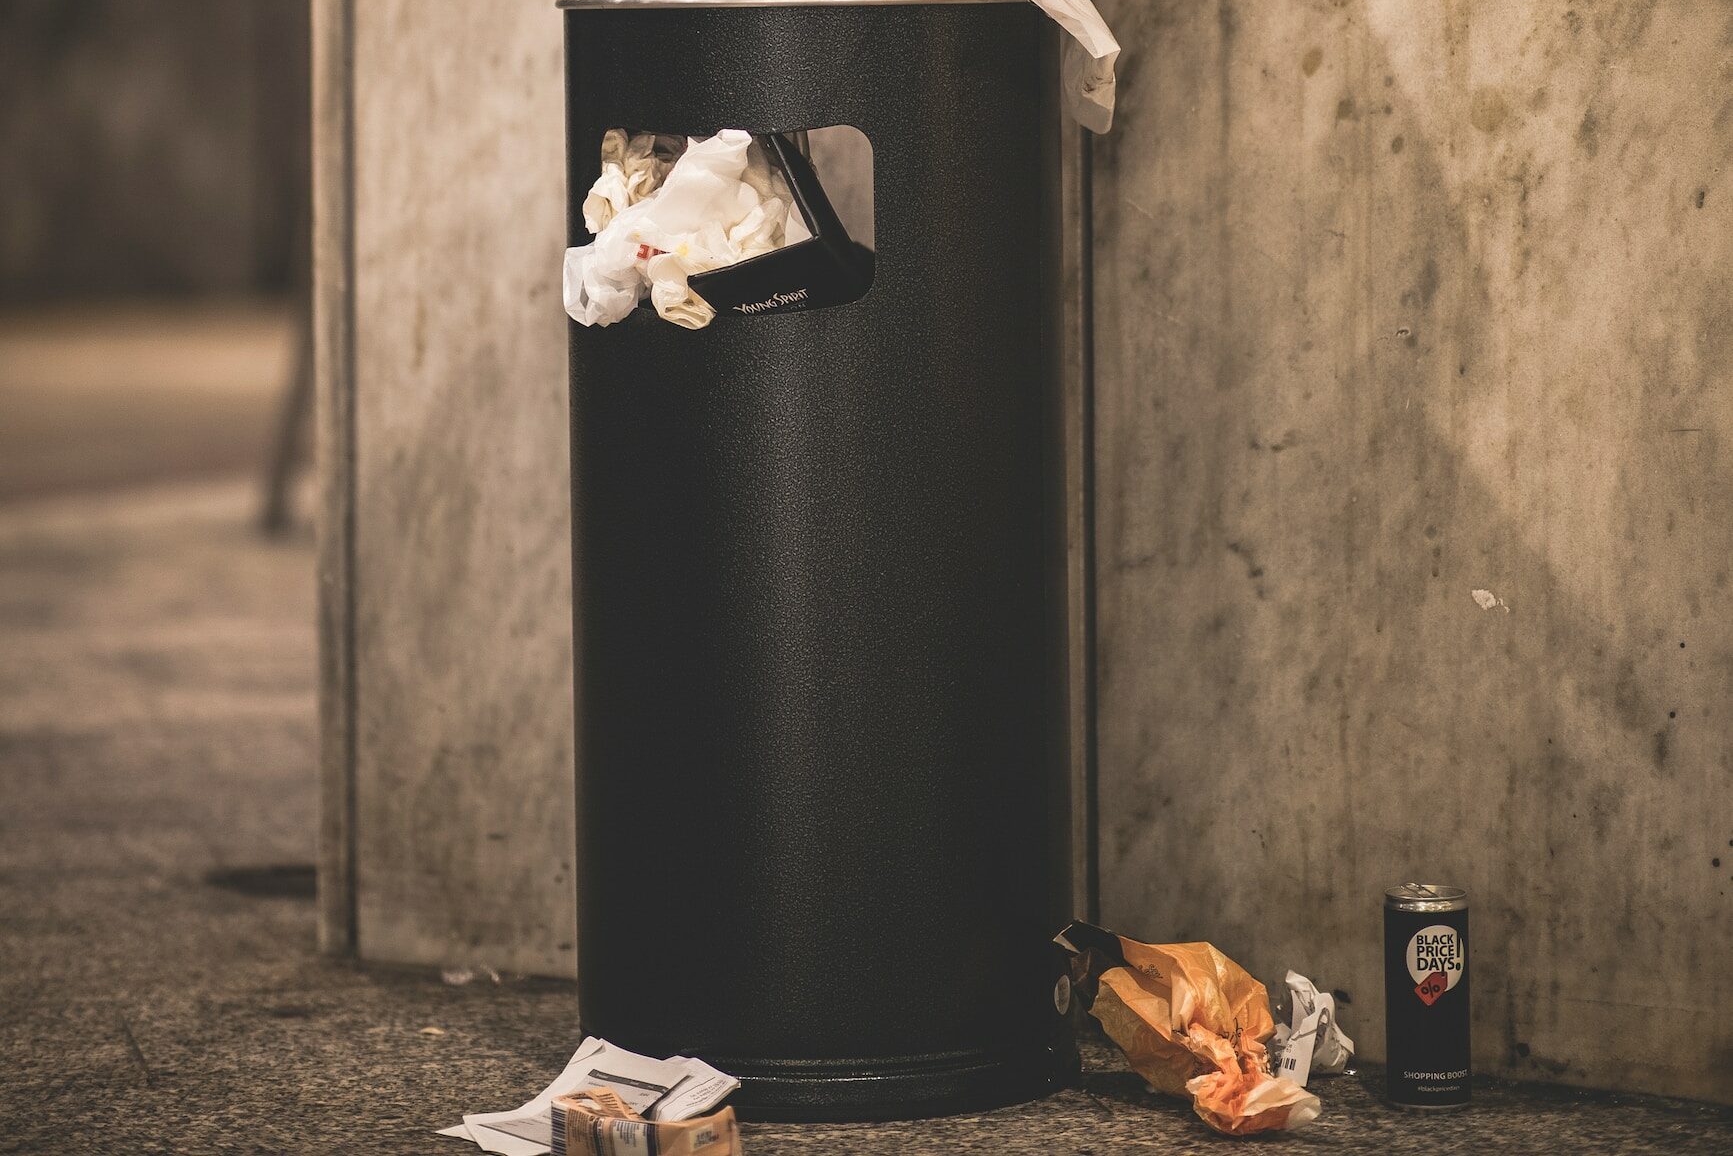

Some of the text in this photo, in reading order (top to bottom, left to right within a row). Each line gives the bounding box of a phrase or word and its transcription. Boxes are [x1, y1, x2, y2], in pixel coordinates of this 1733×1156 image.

[1416, 934, 1454, 945] BLACK
[1416, 945, 1455, 957] PRICE
[1403, 1069, 1468, 1080] SHOPPING BOOST
